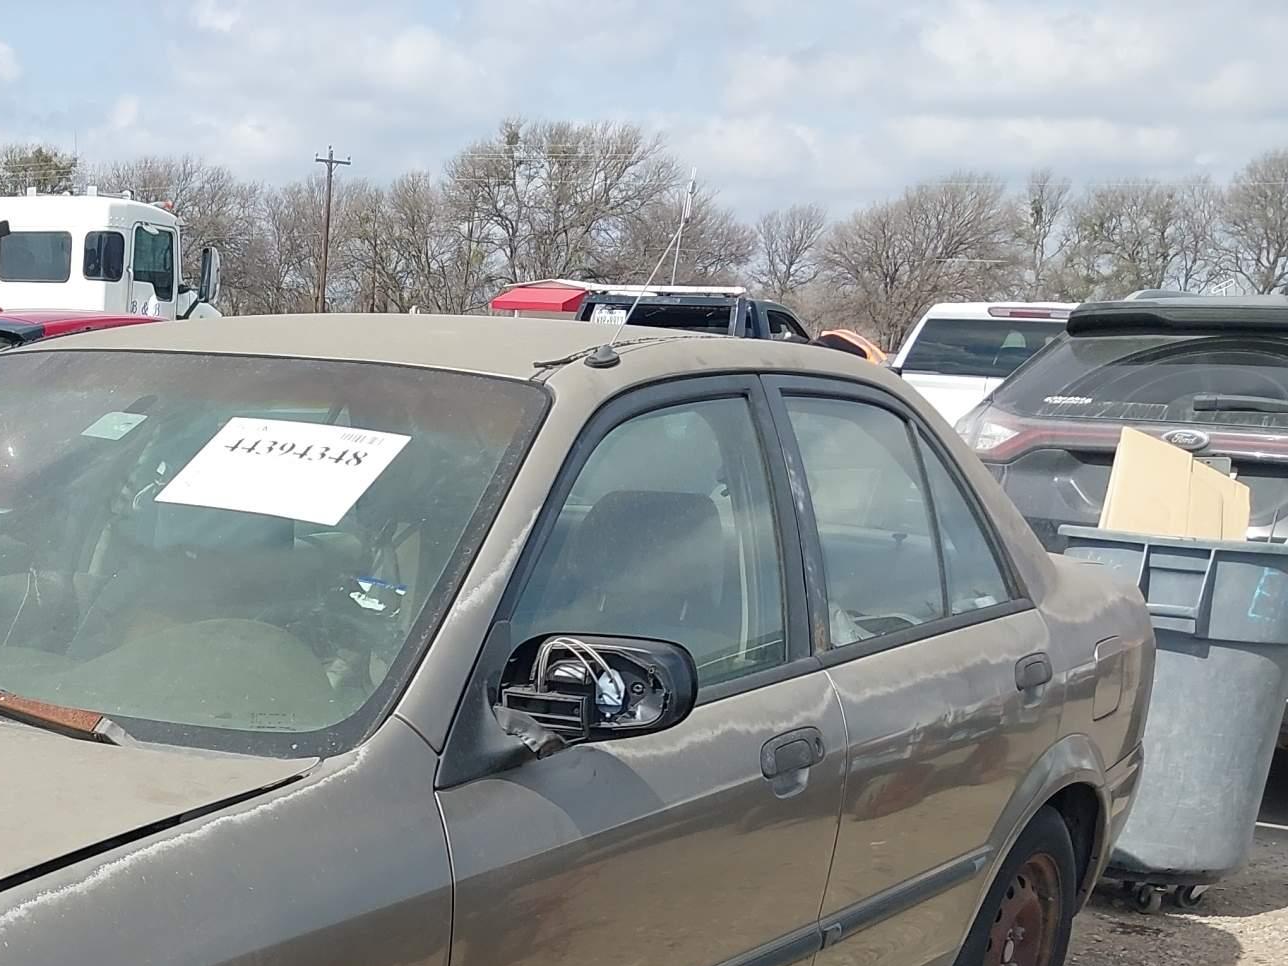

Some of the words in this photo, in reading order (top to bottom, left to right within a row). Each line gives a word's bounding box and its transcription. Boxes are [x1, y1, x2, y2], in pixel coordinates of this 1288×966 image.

[130, 300, 138, 314] B
[141, 301, 149, 316] &
[1171, 432, 1198, 445] Ford
[224, 437, 368, 467] 44394348
